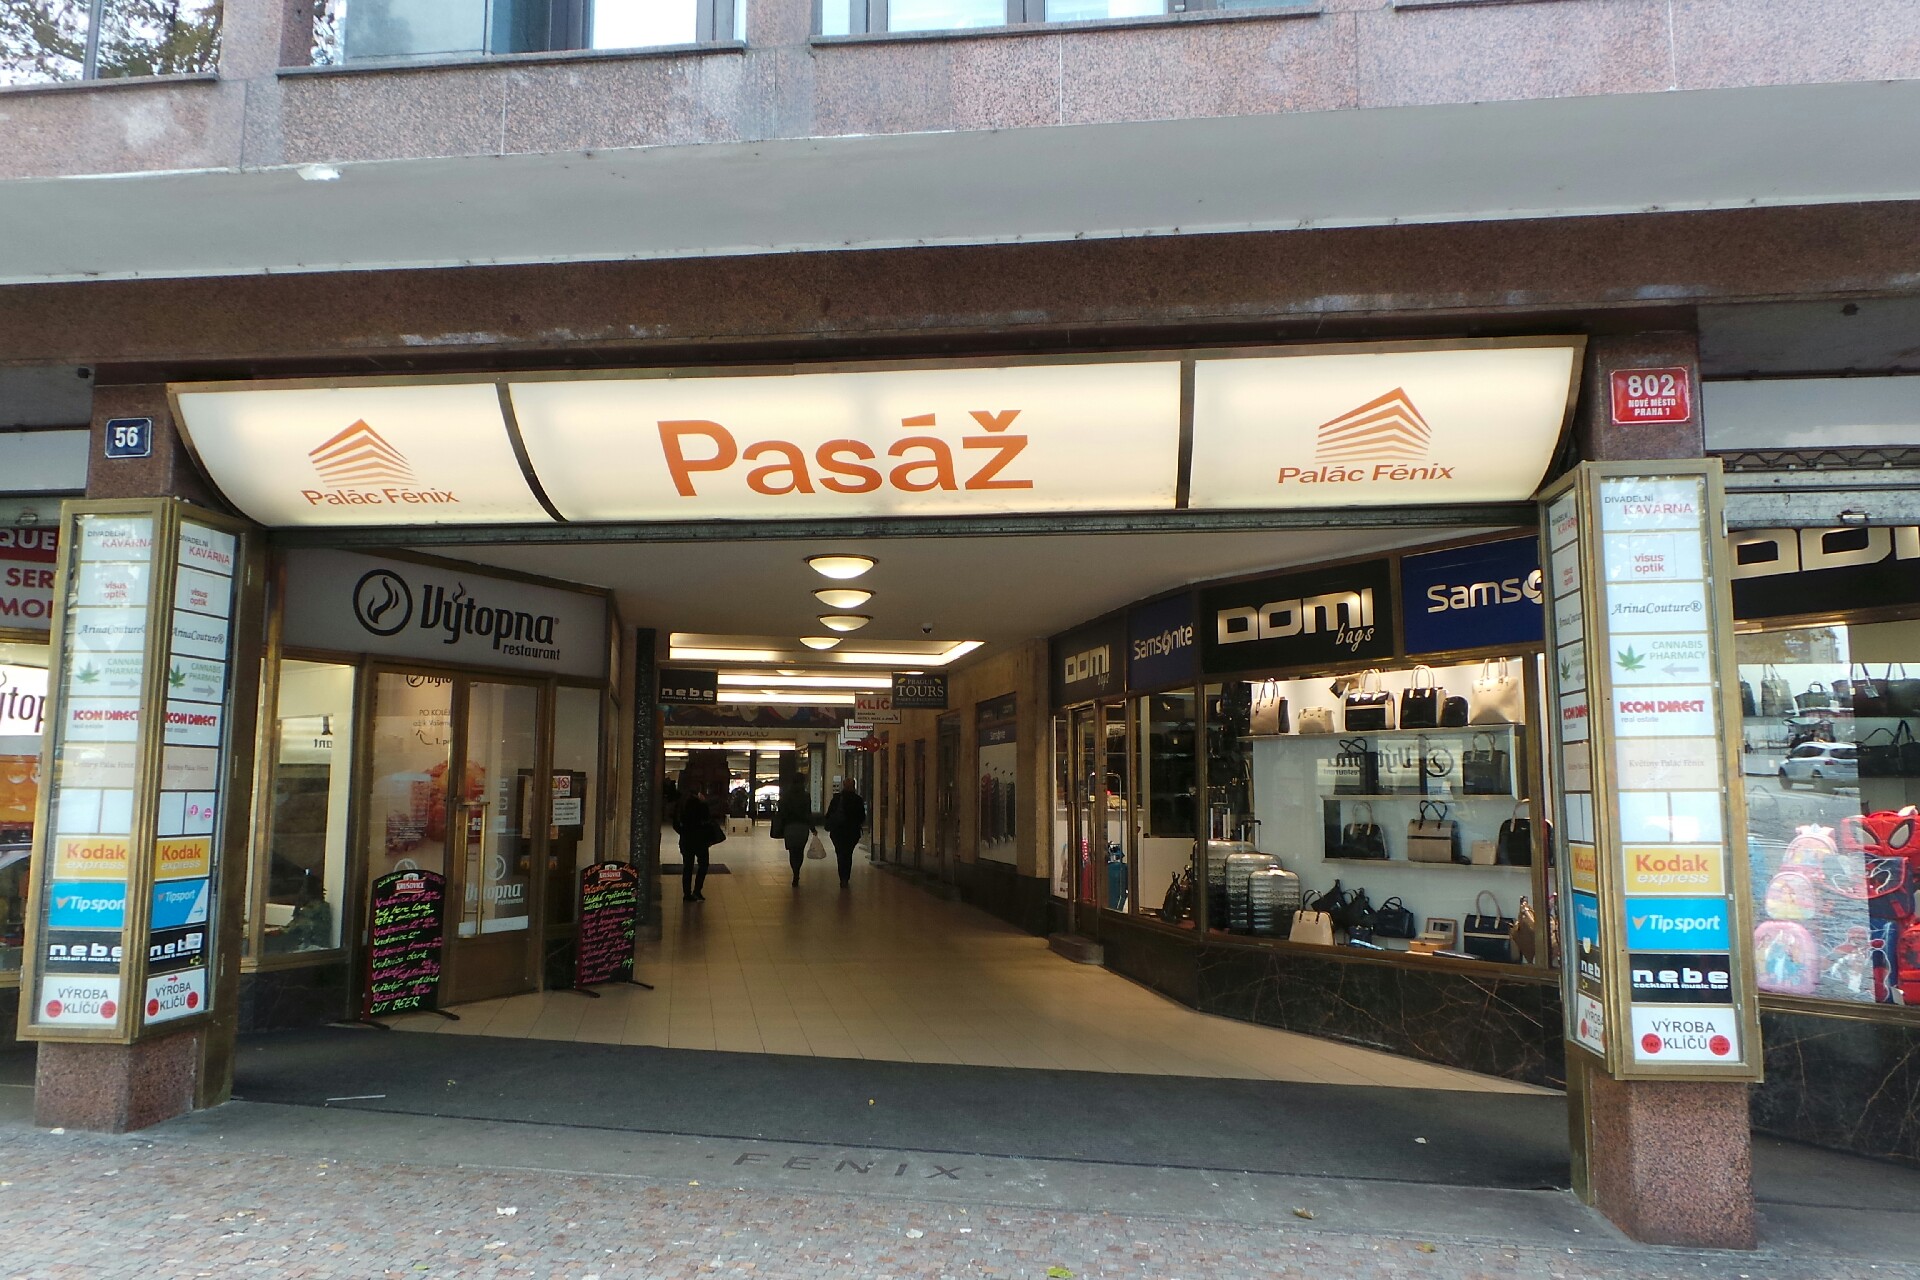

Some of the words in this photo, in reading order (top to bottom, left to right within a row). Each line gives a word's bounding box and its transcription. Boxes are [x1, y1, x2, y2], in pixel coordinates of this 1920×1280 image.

[1628, 374, 1675, 397] 802
[1628, 397, 1649, 408] NOVÉ
[1650, 397, 1676, 407] MĚSTO
[1634, 408, 1663, 416] PRAHA
[114, 426, 138, 448] 56
[657, 409, 1033, 497] Pasáž
[1278, 465, 1364, 484] Palác
[1372, 462, 1456, 482] Fénix
[301, 489, 382, 506] Palác
[382, 487, 460, 504] Fénix
[1634, 553, 1664, 563] visus
[1634, 563, 1665, 574] optik
[1217, 588, 1374, 645] DOMI
[1133, 621, 1193, 662] Samsonite
[1335, 621, 1374, 653] bags
[1652, 640, 1703, 649] CANNABIS
[503, 643, 560, 661] restaurant
[1649, 651, 1706, 661] PHARMACY
[1065, 644, 1110, 684] DOMI
[661, 687, 714, 698] nebe
[896, 685, 944, 698] TOURS
[1619, 701, 1657, 713] ICON
[1658, 700, 1705, 713] DIRECT
[67, 843, 126, 860] Kodak
[162, 844, 201, 861] Kodak
[1636, 854, 1708, 871] Kodak
[1636, 872, 1709, 884] express
[165, 889, 196, 903] Tipsport
[1649, 914, 1721, 933] Tipsport
[1632, 967, 1729, 984] nebe
[58, 987, 109, 1000] VÝROBA
[155, 981, 191, 999] VÝROBA
[393, 996, 421, 1010] BEER
[1651, 1017, 1716, 1033] VÝROBA
[732, 1152, 964, 1180] FENIX
